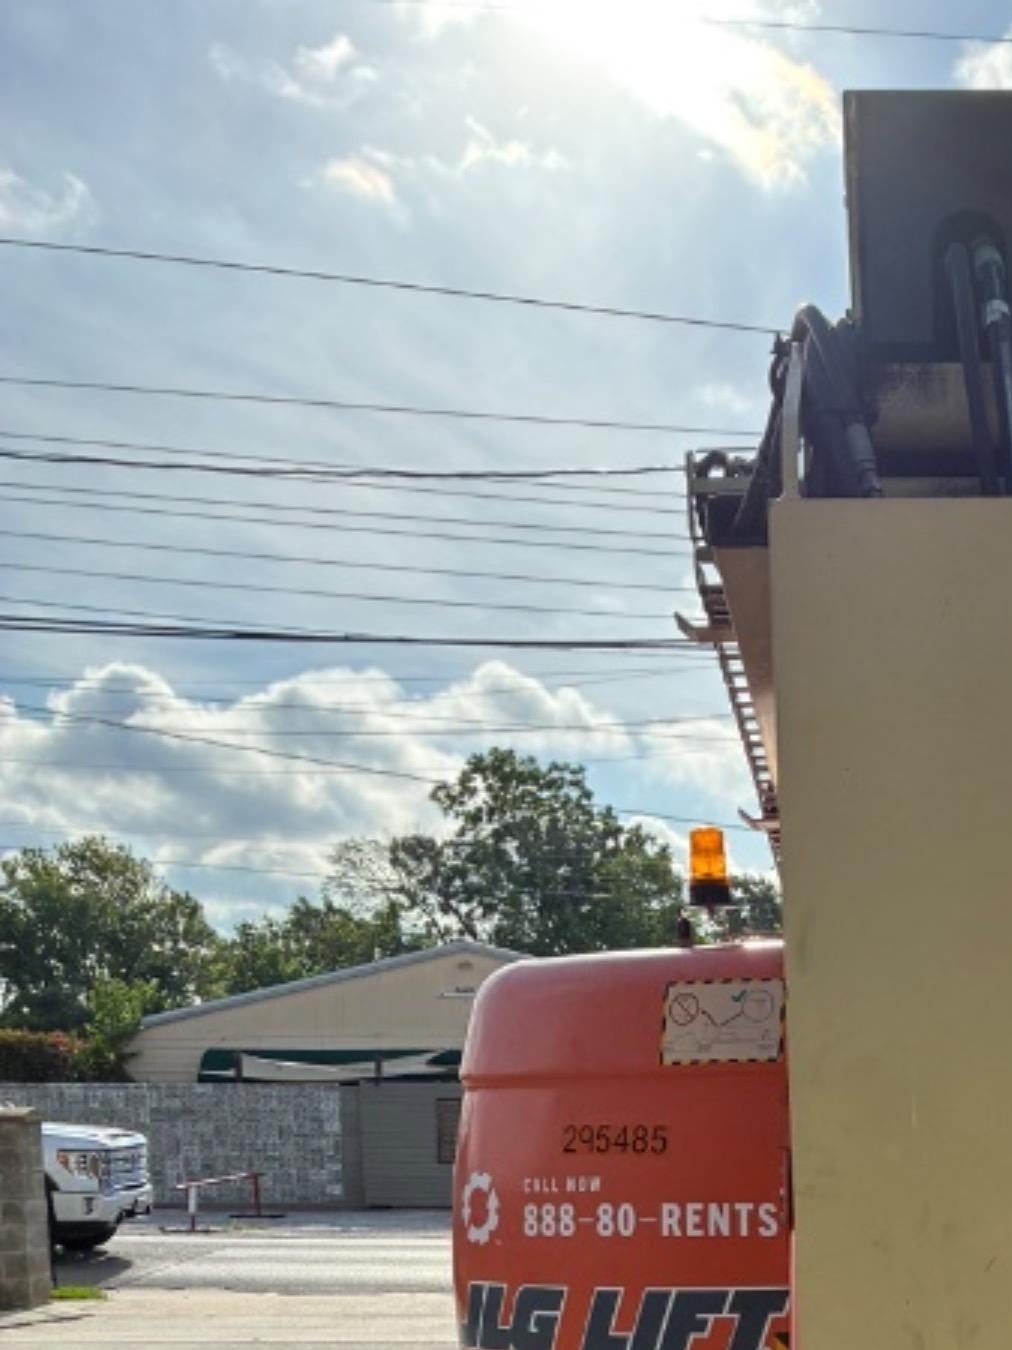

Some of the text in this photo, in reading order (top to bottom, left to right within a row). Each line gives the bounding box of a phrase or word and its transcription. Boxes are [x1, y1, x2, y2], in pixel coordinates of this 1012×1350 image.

[562, 1124, 668, 1154] 295485
[523, 1176, 601, 1193] CALL NOW
[523, 1202, 779, 1238] 888-80-RENTS
